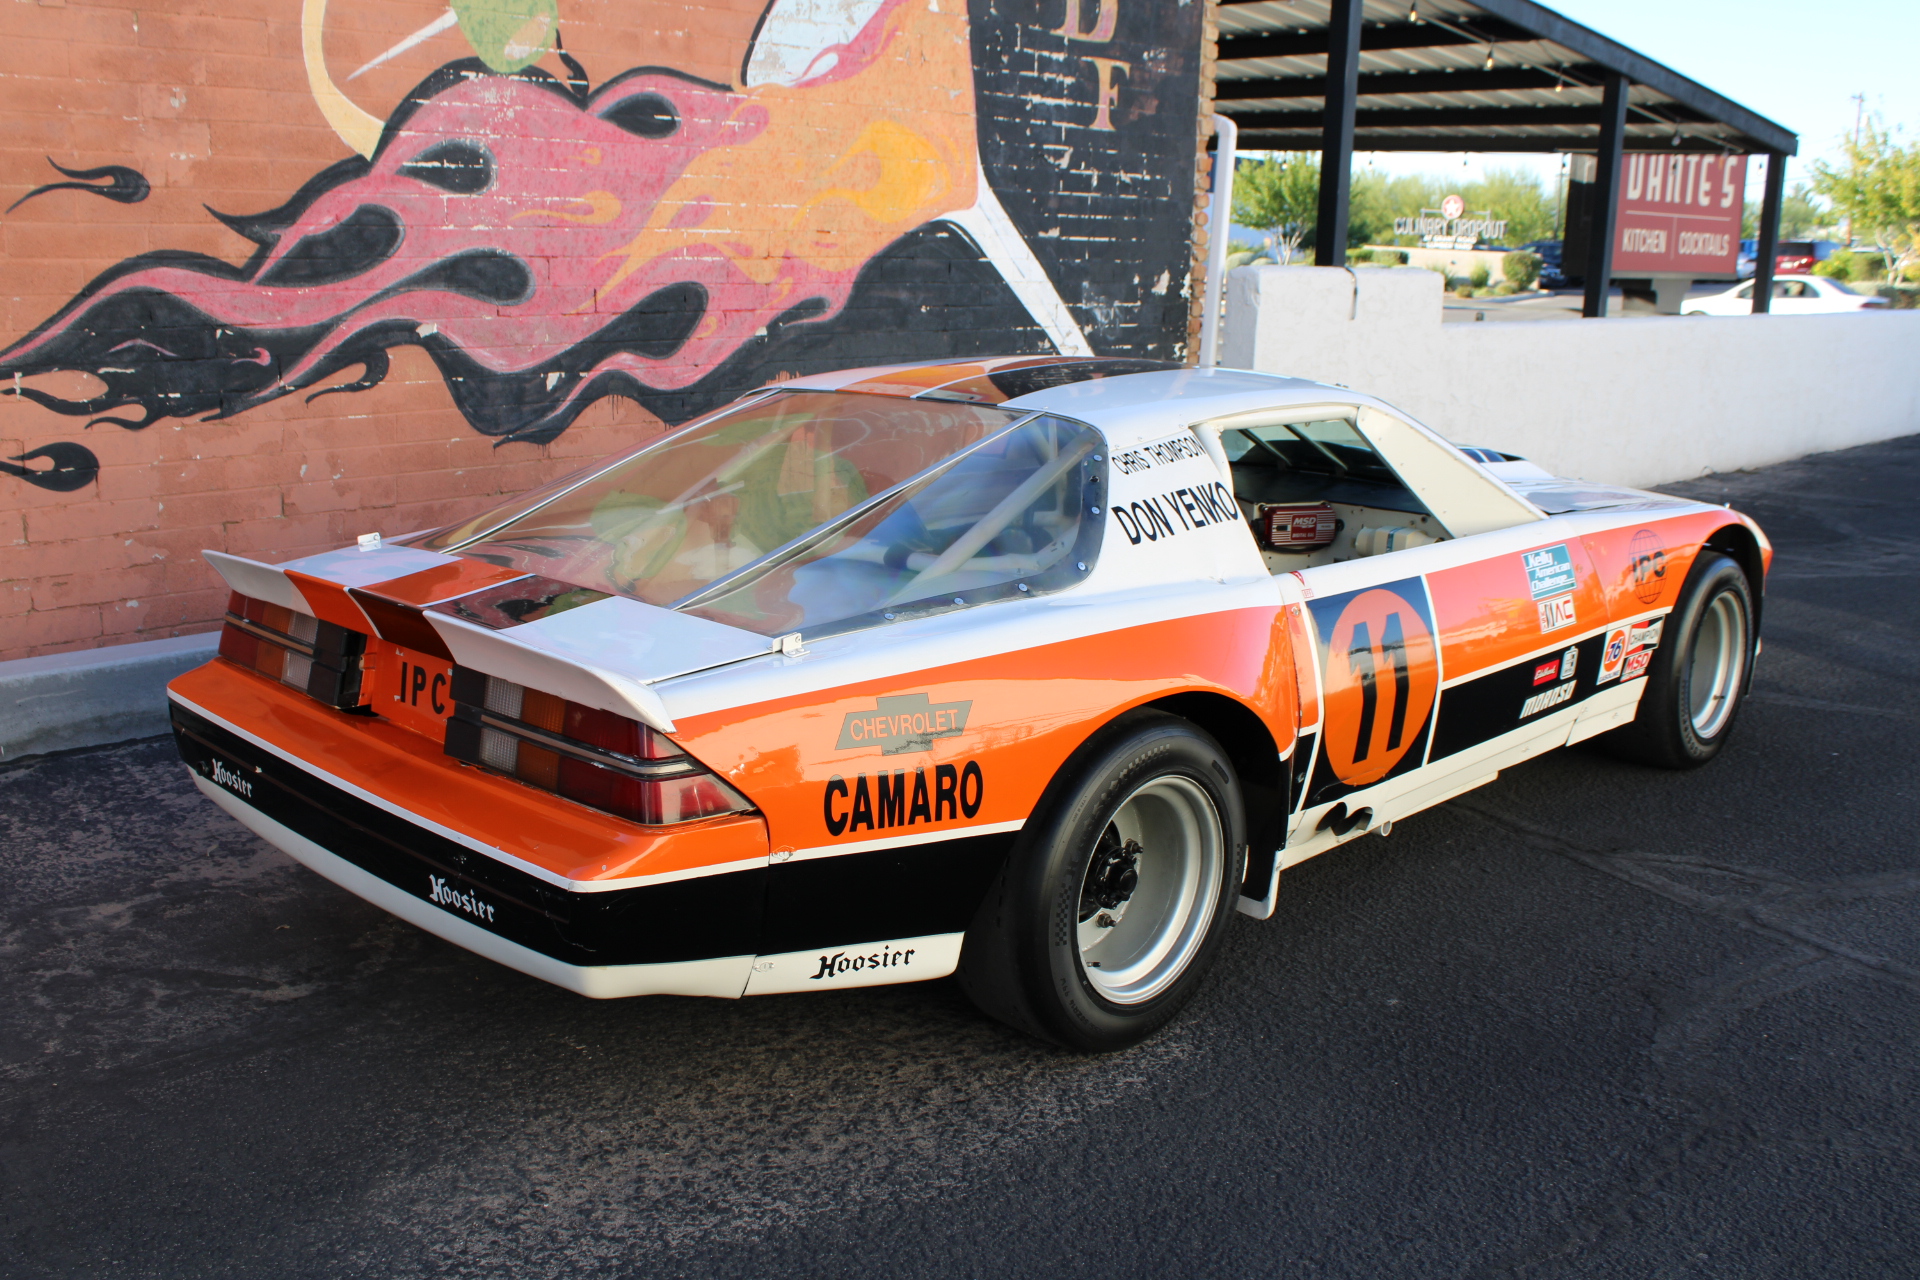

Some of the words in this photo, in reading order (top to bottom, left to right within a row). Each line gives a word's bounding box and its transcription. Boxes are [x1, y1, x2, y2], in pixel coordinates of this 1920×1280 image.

[1085, 57, 1132, 131] F
[1394, 217, 1449, 236] CULINARY
[1451, 218, 1508, 239] DROPOUT
[1622, 228, 1668, 254] KITCHEN
[1678, 231, 1730, 257] COCKTAILS
[1111, 450, 1151, 475] CHRIS
[1143, 435, 1207, 466] THOMPSON
[1111, 496, 1175, 546] DON
[1161, 481, 1239, 531] YENKO
[1293, 517, 1317, 526] MSD
[1528, 551, 1555, 568] Kelly
[1535, 562, 1572, 580] American
[1631, 550, 1667, 583] IPC
[1531, 574, 1569, 593] Challenge
[1605, 636, 1625, 663] 76
[1630, 628, 1660, 646] CHAMPION
[1624, 651, 1650, 674] MSD
[400, 661, 447, 715] IPC
[1347, 612, 1411, 765] 11
[850, 708, 958, 741] CHEVROLET
[211, 758, 253, 798] Hoosier
[823, 760, 984, 836] CAMARO
[429, 874, 495, 922] Hoosier
[809, 945, 916, 979] Hoosier
